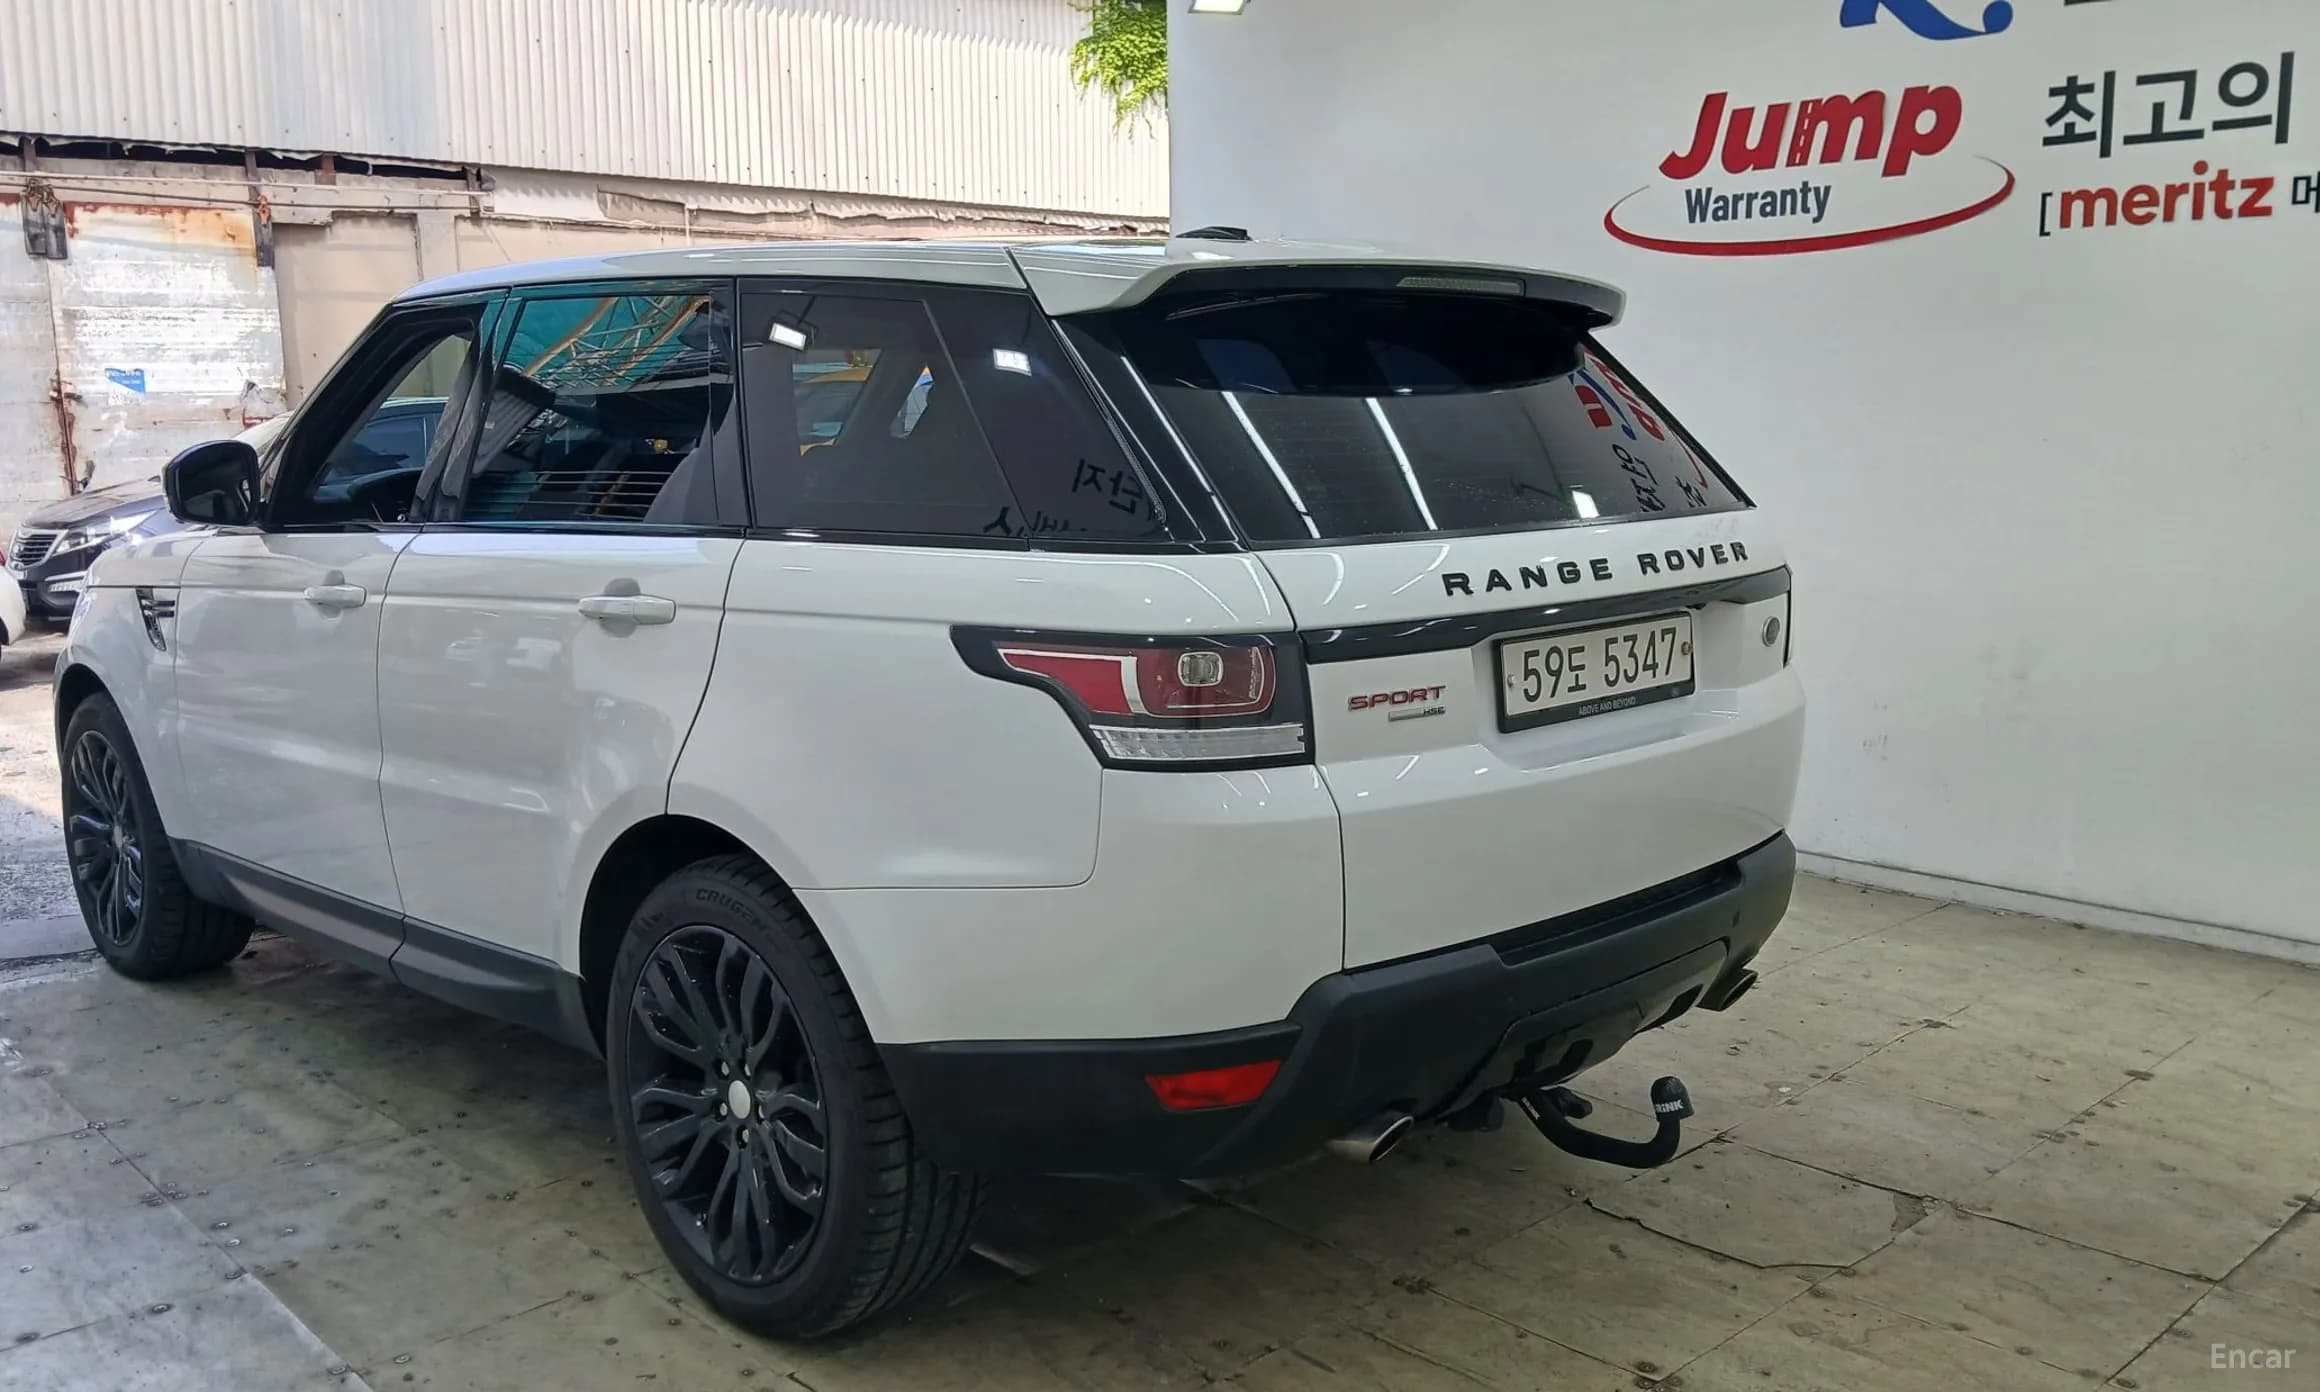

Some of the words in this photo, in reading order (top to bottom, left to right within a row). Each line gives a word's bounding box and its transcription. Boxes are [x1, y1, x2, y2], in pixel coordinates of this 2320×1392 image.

[2042, 51, 2294, 158] 최고의
[1658, 85, 1963, 180] Jump
[1685, 181, 1832, 224] Warranty
[1441, 557, 1614, 597] RANGE
[1637, 541, 1749, 575] ROVER
[1523, 645, 1587, 703] 59도
[1604, 627, 1677, 687] 5347
[1348, 685, 1447, 711] SPORT
[1423, 706, 1447, 718] HSE
[1600, 700, 1612, 711] AND
